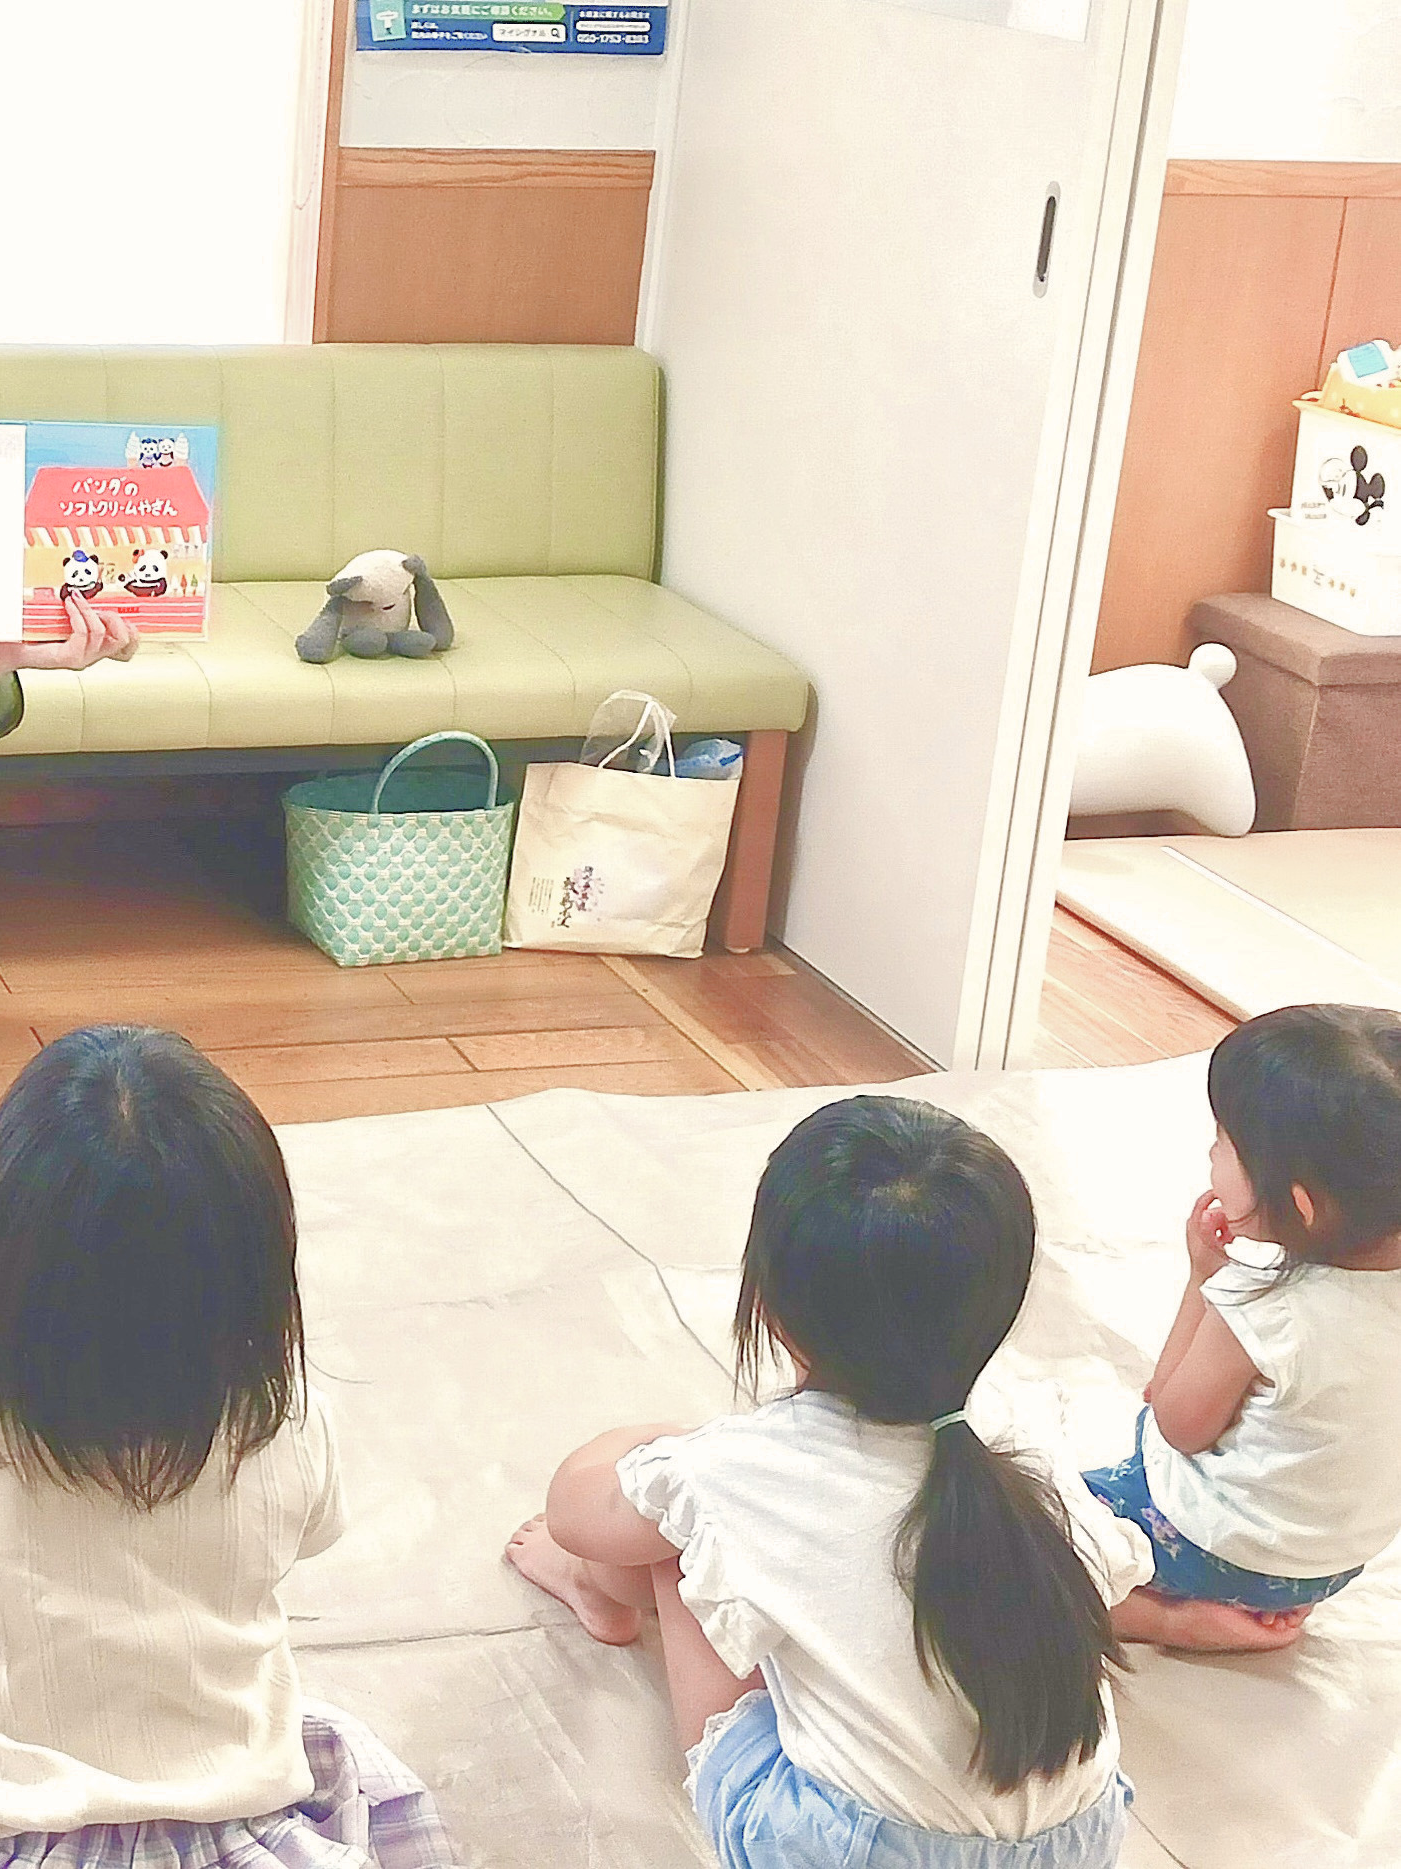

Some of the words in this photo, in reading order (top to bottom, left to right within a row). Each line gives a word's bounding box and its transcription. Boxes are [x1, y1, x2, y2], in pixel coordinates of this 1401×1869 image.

[72, 477, 139, 496] パンダの
[59, 498, 178, 517] ソフトクリームやさん
